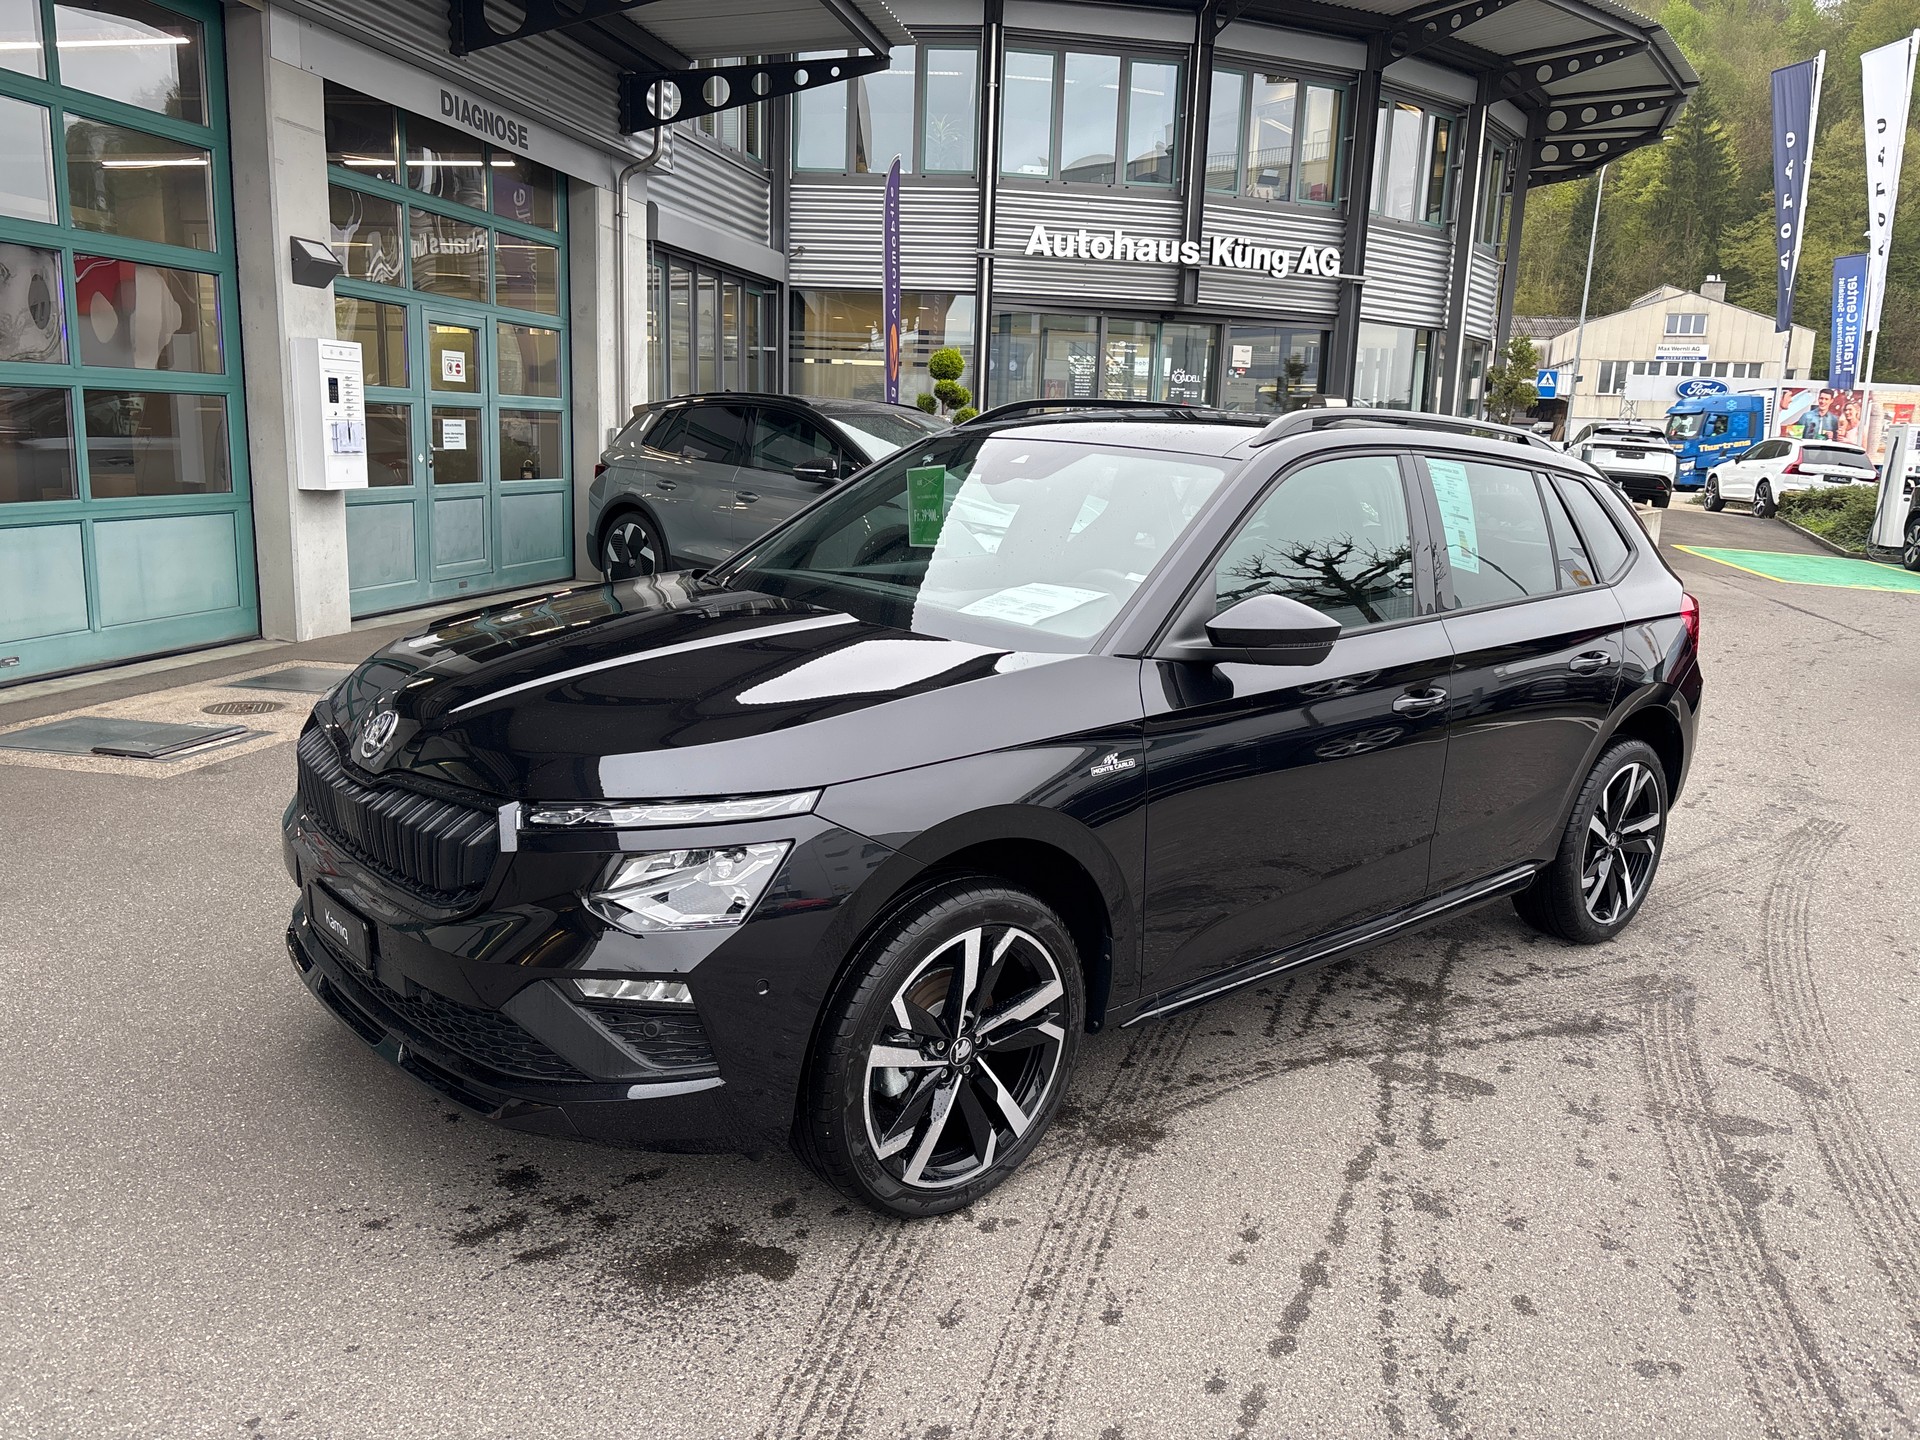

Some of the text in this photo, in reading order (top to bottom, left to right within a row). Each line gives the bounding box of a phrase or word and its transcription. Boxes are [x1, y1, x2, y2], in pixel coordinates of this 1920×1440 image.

[440, 88, 529, 150] DIAGNOSE
[1024, 225, 1341, 279] Autohaus Küng AG
[1686, 381, 1726, 397] Ford
[1093, 760, 1134, 775] MONTE CARLO
[324, 907, 349, 946] Kamiq
